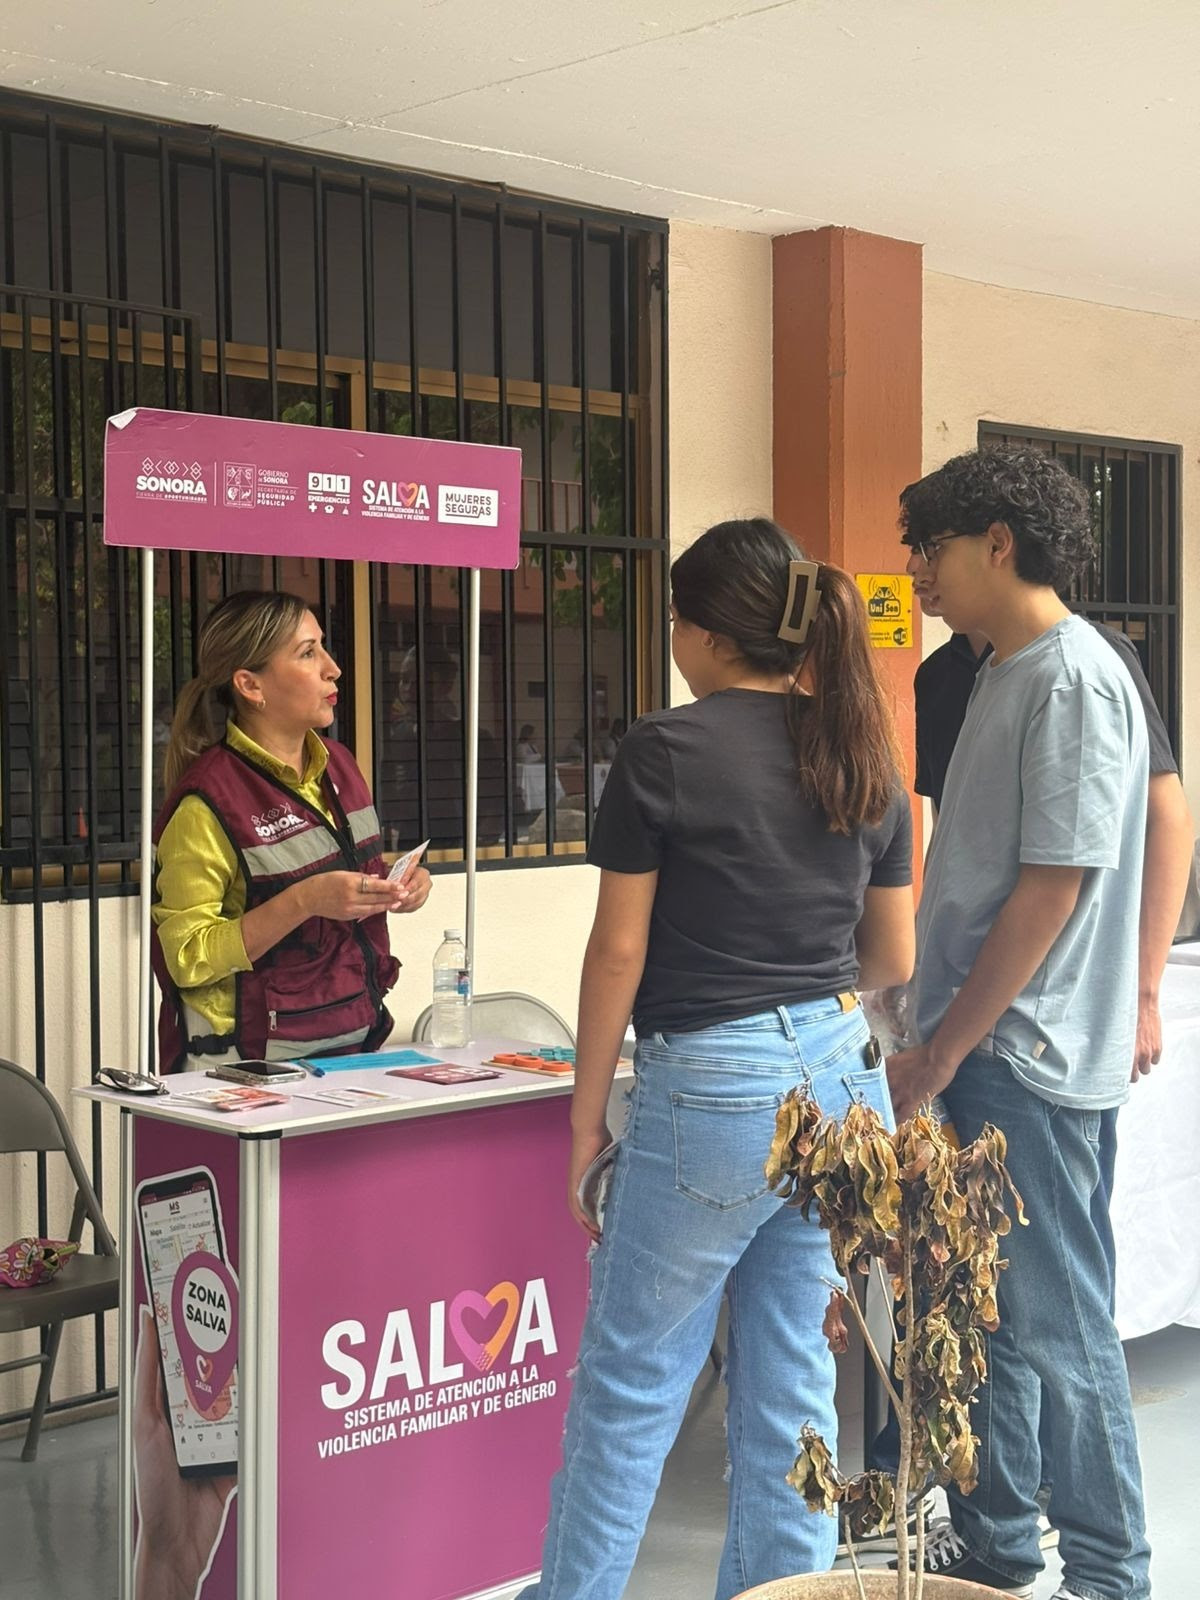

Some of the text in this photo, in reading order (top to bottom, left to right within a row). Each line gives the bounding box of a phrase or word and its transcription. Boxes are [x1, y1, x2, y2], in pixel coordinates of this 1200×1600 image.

[258, 468, 289, 478] GOBIERNO
[263, 475, 289, 485] SONORA
[136, 475, 208, 496] SONORA
[311, 475, 346, 490] 911
[257, 492, 295, 501] SEGURIDAD
[308, 494, 351, 505] EMERGENCIAS
[362, 479, 431, 509] SALVA
[445, 492, 492, 506] MUJERES
[257, 498, 286, 507] PÚBLICA
[445, 503, 492, 517] SEGURAS
[169, 1201, 181, 1211] MS
[188, 1281, 227, 1312] ZONA
[186, 1303, 227, 1336] SALVA
[320, 1277, 559, 1411] SALVA
[344, 1364, 539, 1430] SISTEMA DE ATENCIÓN A LA
[317, 1379, 557, 1460] VIOLENCIA FAMILIAR Y DE GÉNERO
